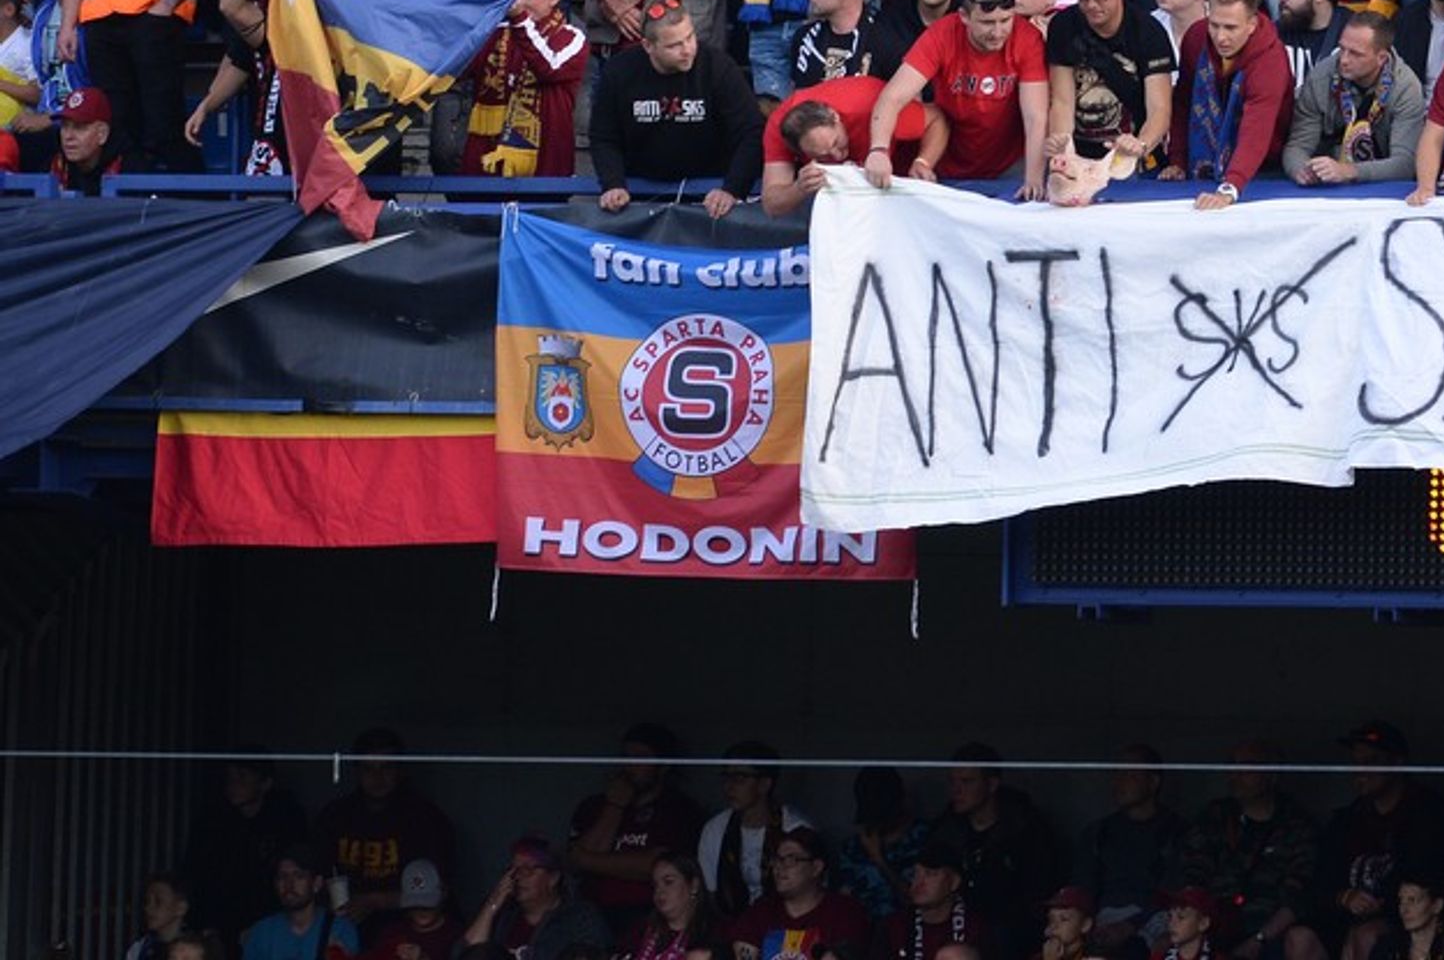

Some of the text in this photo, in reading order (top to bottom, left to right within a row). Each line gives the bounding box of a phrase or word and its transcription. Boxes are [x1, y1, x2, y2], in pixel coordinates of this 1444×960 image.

[590, 241, 681, 285] fan
[632, 317, 726, 372] SPARTA
[738, 333, 769, 426] PRAHA
[819, 246, 1117, 468] ANTI
[651, 441, 738, 473] FOTBAL
